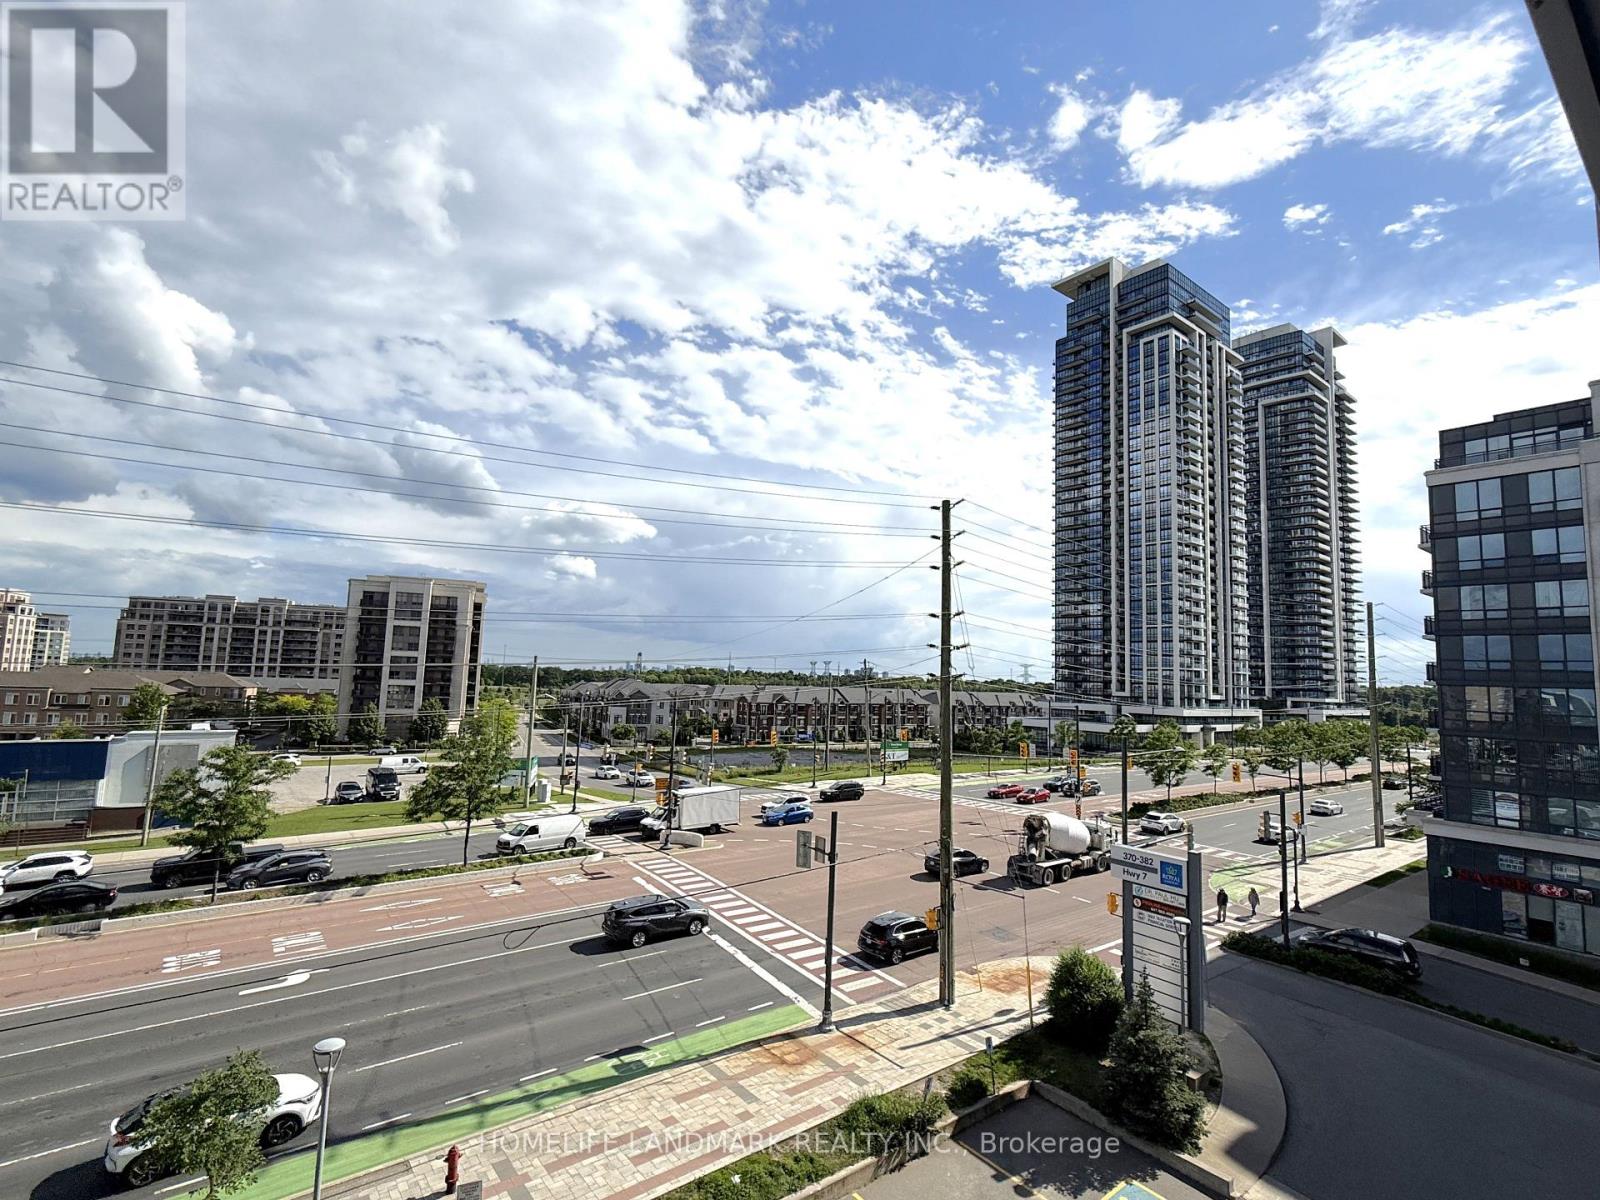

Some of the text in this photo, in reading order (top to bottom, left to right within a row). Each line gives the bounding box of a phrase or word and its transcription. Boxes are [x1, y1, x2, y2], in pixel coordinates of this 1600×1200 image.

[1123, 852, 1154, 866] 370-382
[1122, 867, 1148, 881] Hwy 7
[1162, 873, 1181, 882] ROYAL
